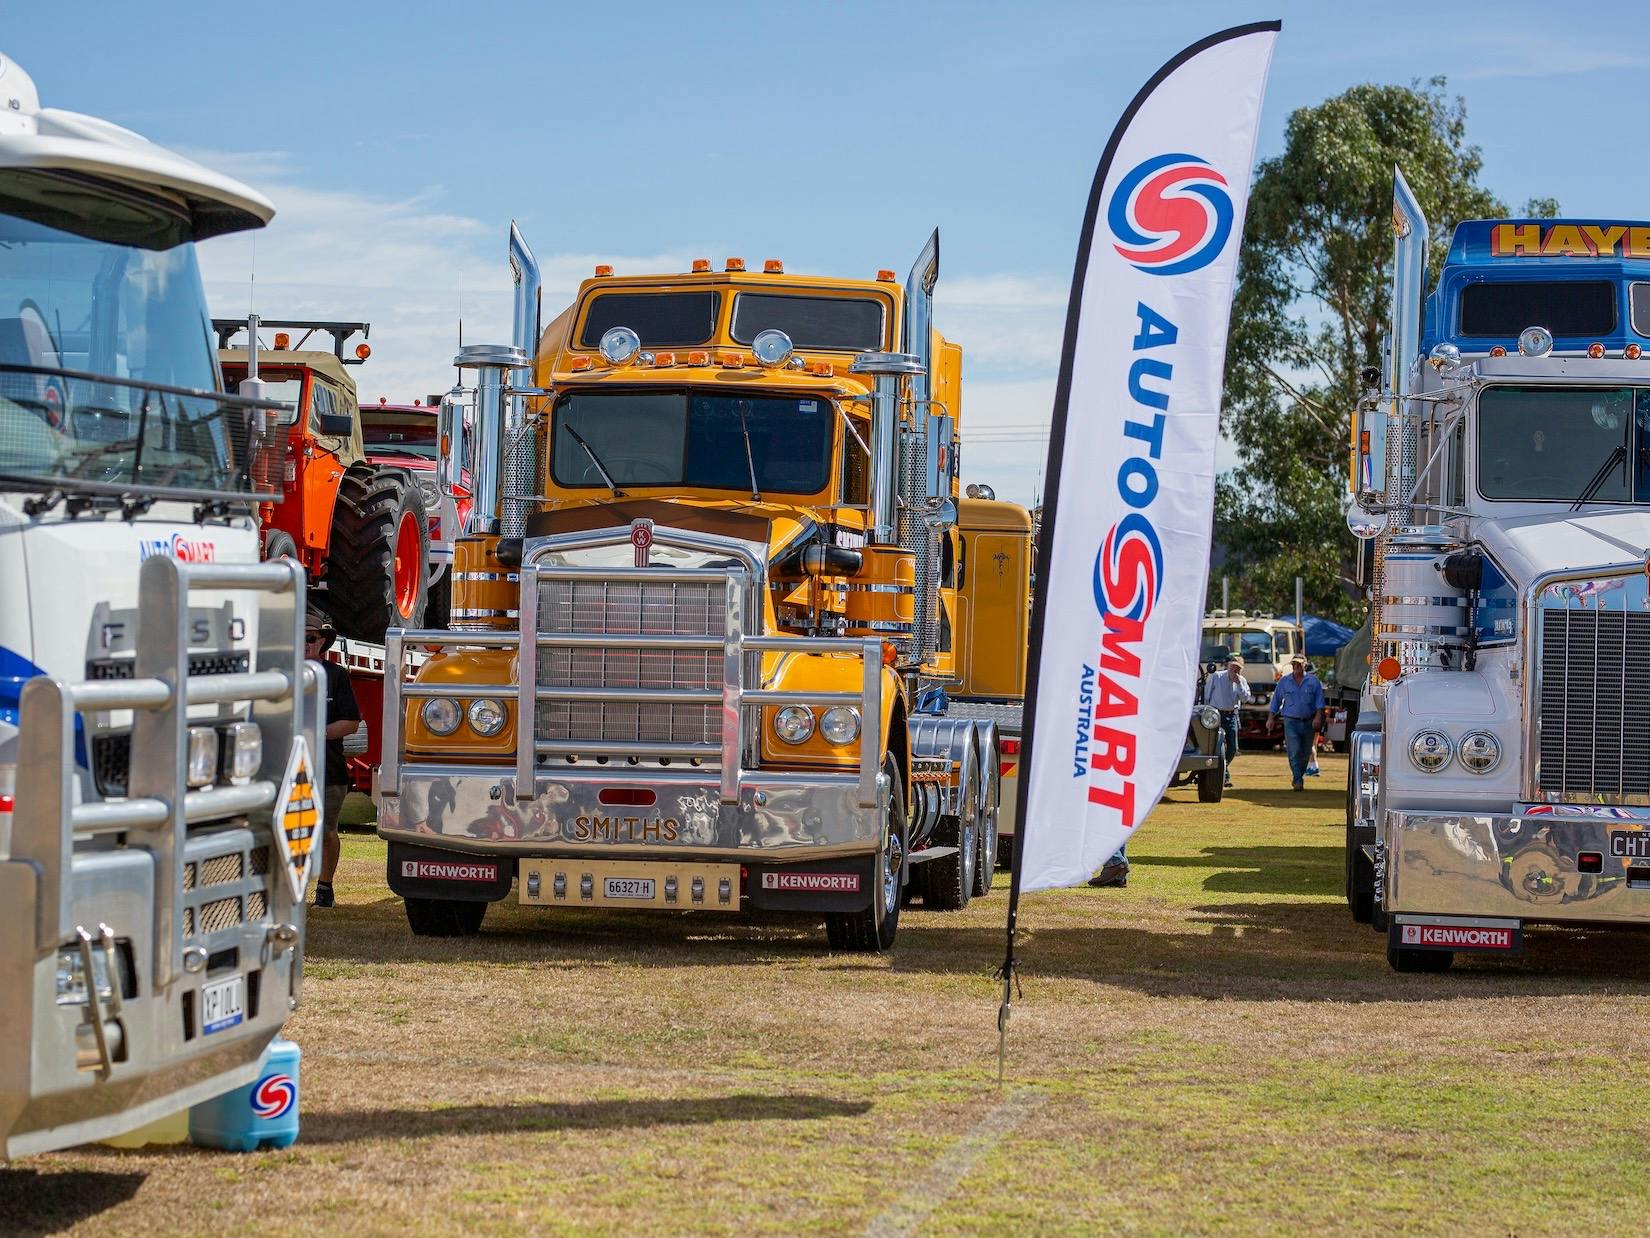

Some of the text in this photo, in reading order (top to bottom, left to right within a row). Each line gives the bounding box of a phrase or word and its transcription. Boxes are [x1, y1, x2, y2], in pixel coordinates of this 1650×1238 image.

[103, 618, 246, 648] FSO
[1073, 663, 1094, 778] AUSTRALIA
[575, 816, 679, 841] SMITHS
[420, 864, 495, 879] KENWORTH
[780, 875, 857, 889] KENWORTH
[1423, 928, 1508, 945] KENWORTH
